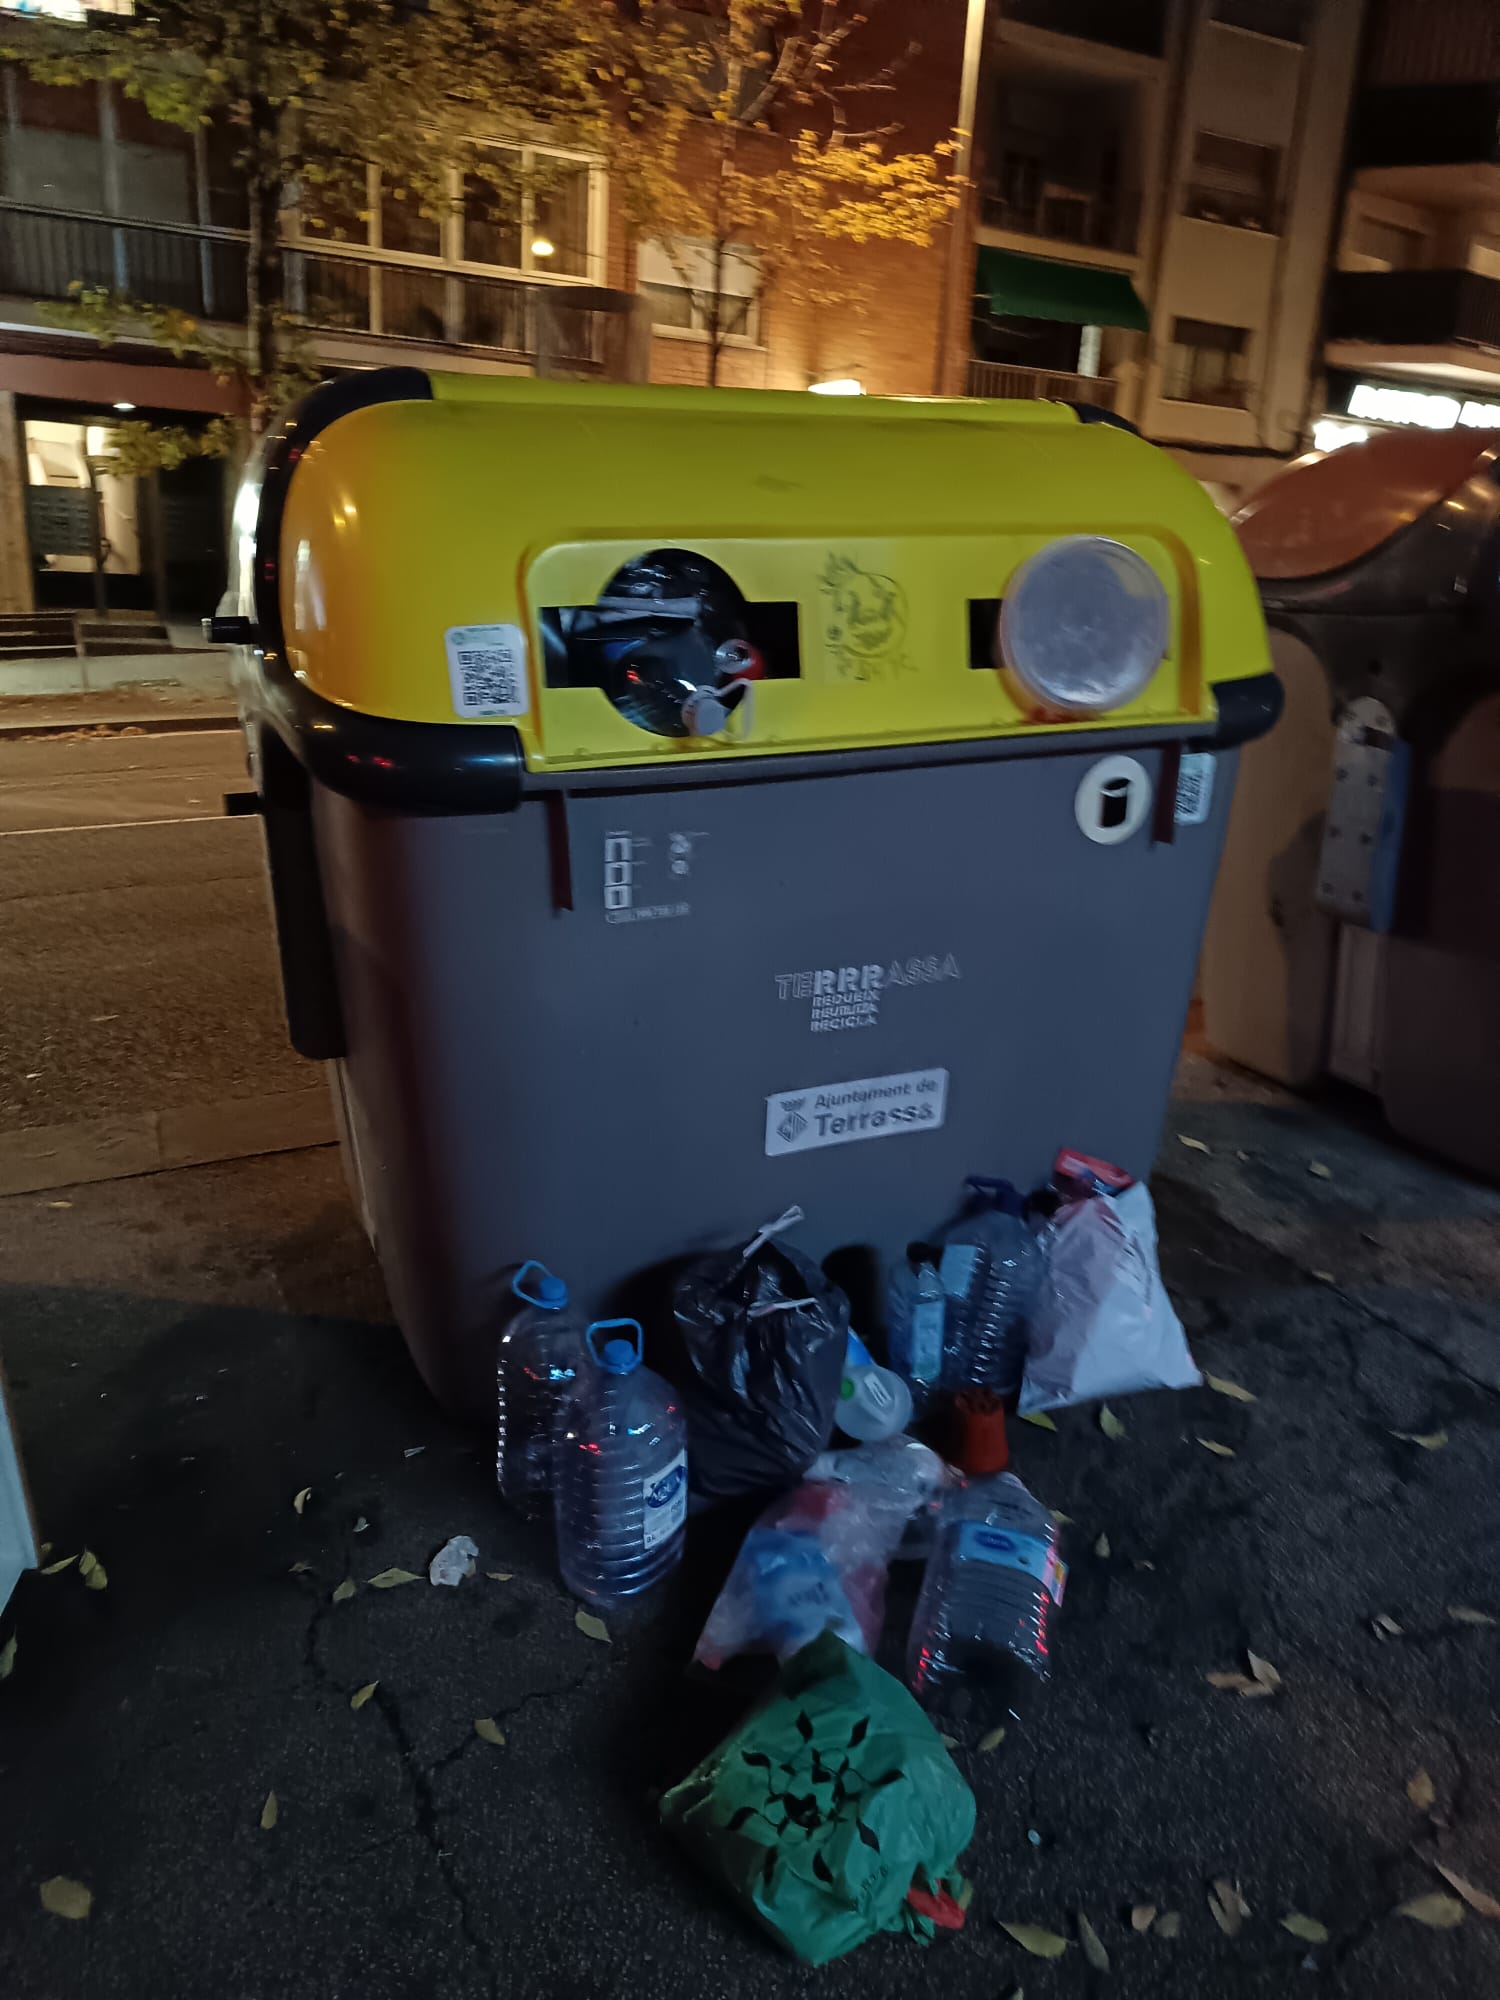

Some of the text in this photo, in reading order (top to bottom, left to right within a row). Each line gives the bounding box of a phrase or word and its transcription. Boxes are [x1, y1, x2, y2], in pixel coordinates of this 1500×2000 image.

[810, 1015, 877, 1032] RECICLA
[814, 1079, 937, 1109] Ajuntament de
[814, 1102, 936, 1136] Terrassa
